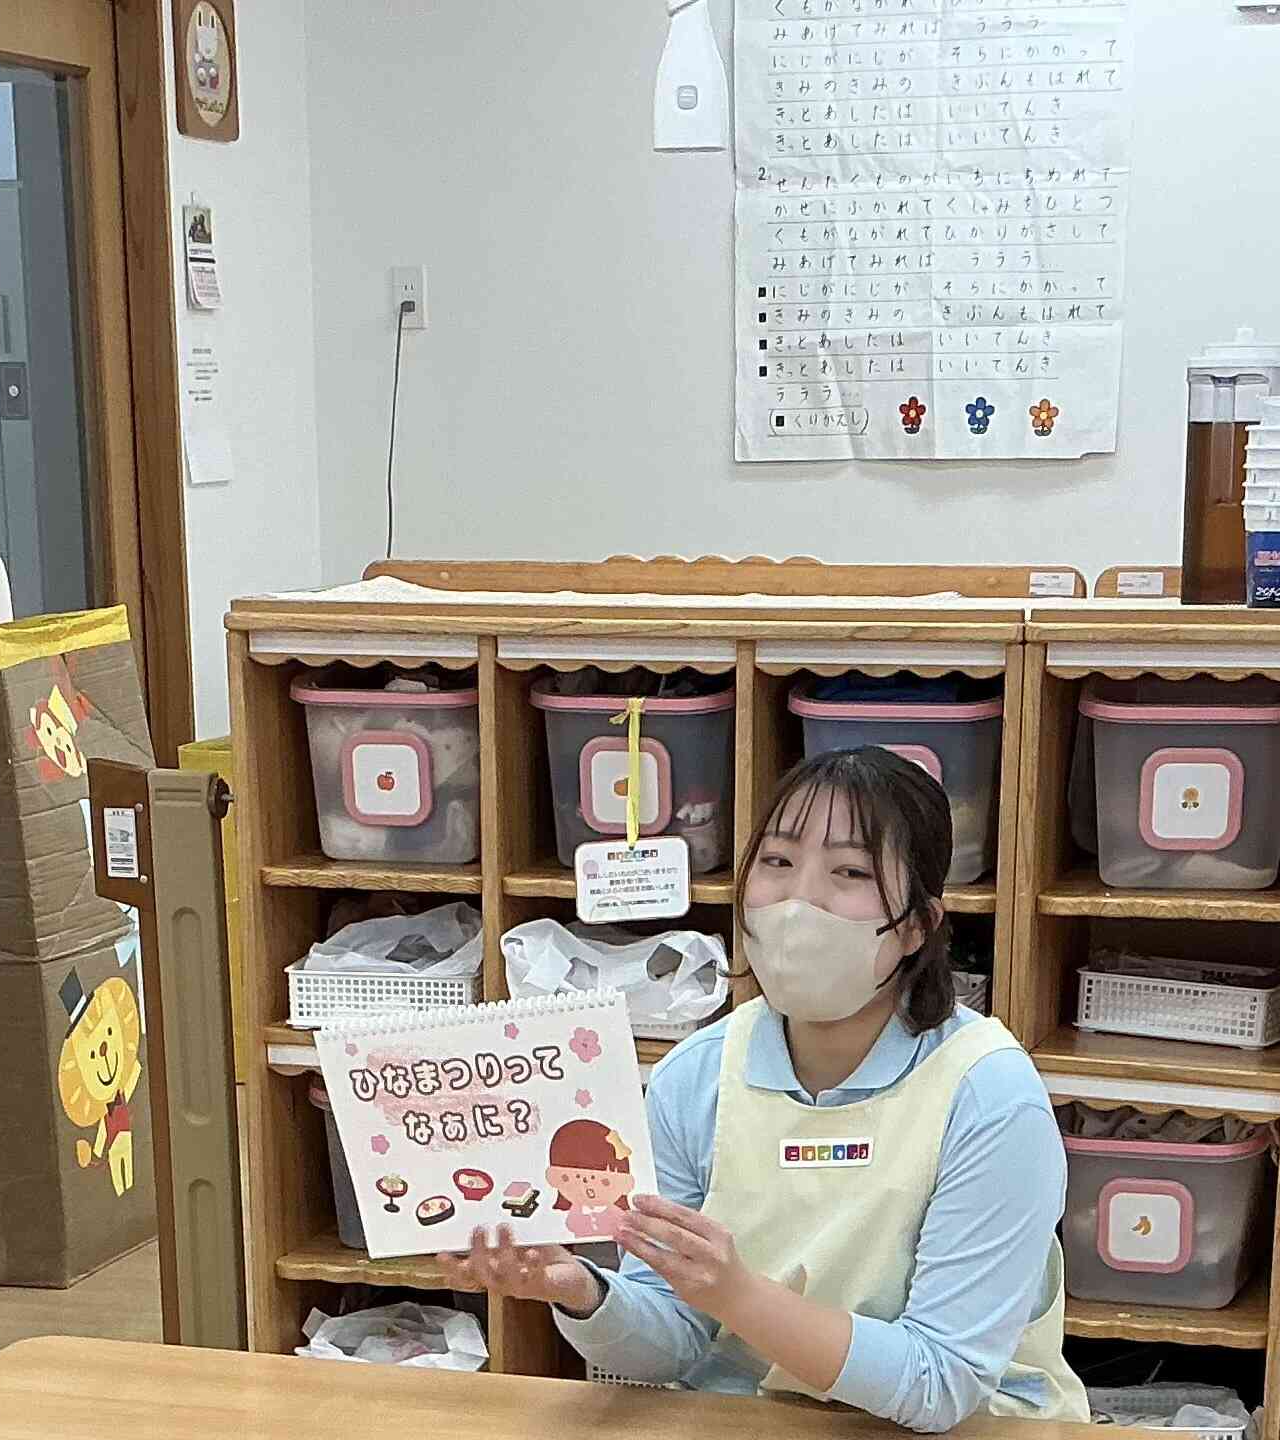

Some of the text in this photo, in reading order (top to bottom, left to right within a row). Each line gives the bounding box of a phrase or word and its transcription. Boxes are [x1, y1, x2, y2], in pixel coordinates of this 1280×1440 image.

[350, 1046, 564, 1101] ひなまつりって
